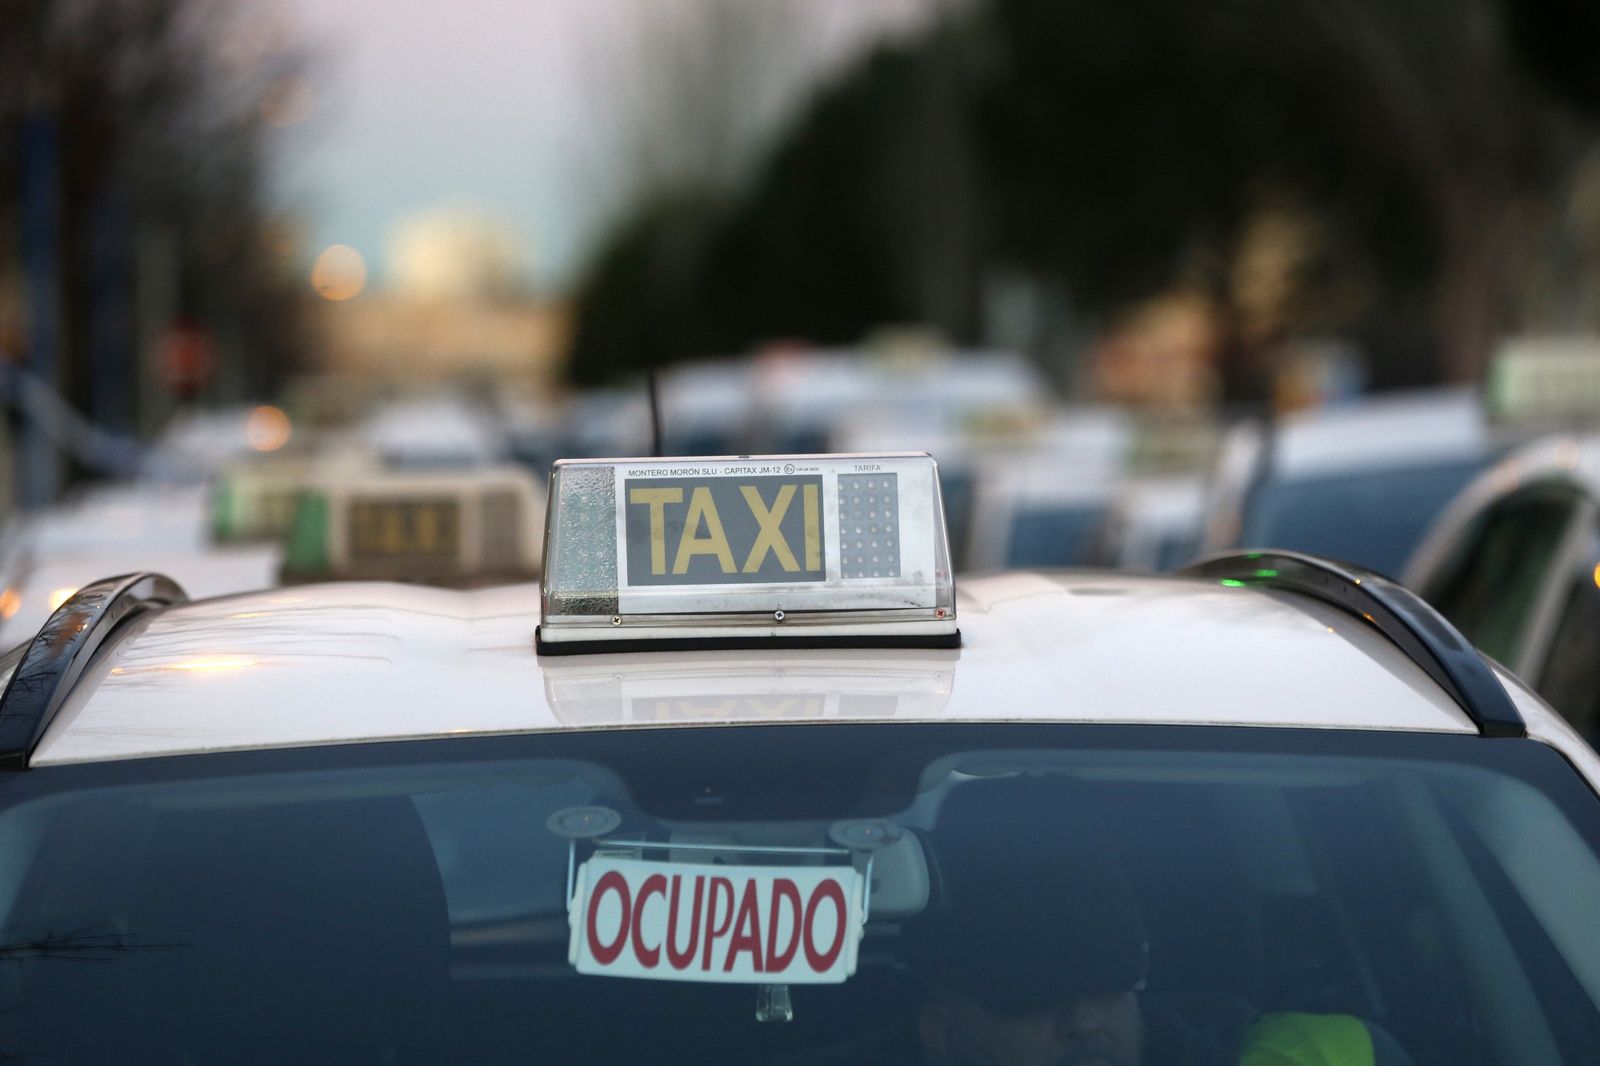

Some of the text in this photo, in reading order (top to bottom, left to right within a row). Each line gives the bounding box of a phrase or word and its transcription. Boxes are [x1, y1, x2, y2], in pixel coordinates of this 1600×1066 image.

[628, 469, 668, 477] MONTERO
[724, 467, 757, 475] CAPITAX
[759, 466, 781, 474] JM-12
[630, 484, 822, 576] TAXI
[586, 870, 847, 973] OCUPADO
